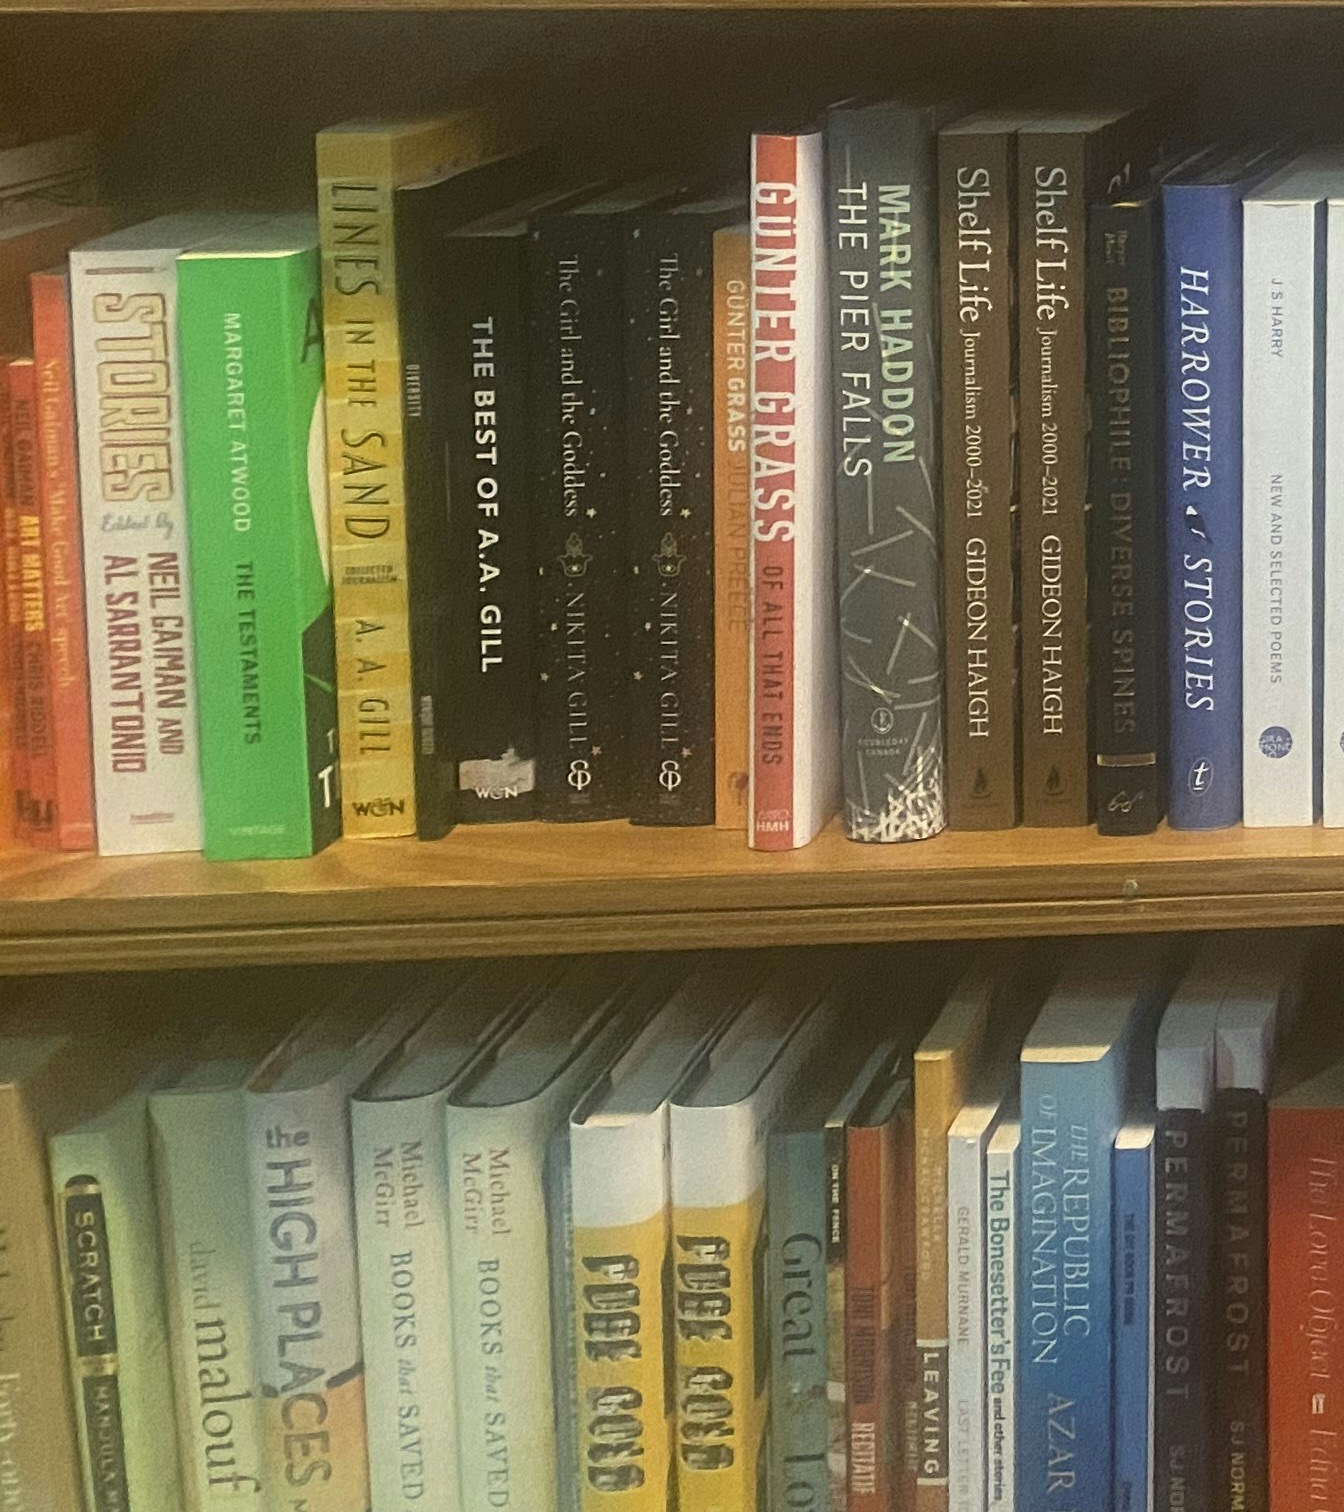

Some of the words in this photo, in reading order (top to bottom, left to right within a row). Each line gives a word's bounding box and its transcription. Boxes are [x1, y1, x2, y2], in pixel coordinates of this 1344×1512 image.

[877, 184, 912, 294] MARK
[1034, 165, 1069, 253] Shelf
[840, 270, 871, 352] PIER
[1038, 255, 1071, 322] Life
[93, 292, 174, 505] STORIES
[222, 312, 248, 432] MARGARET
[471, 318, 496, 378] THE
[880, 308, 916, 466] HADDON
[473, 390, 499, 467] BEST
[842, 371, 873, 480] FALLS
[229, 441, 253, 536] ATWOOD
[236, 561, 256, 601] THE
[237, 608, 263, 747] TESTAMENTS
[267, 1159, 319, 1290] HIGH
